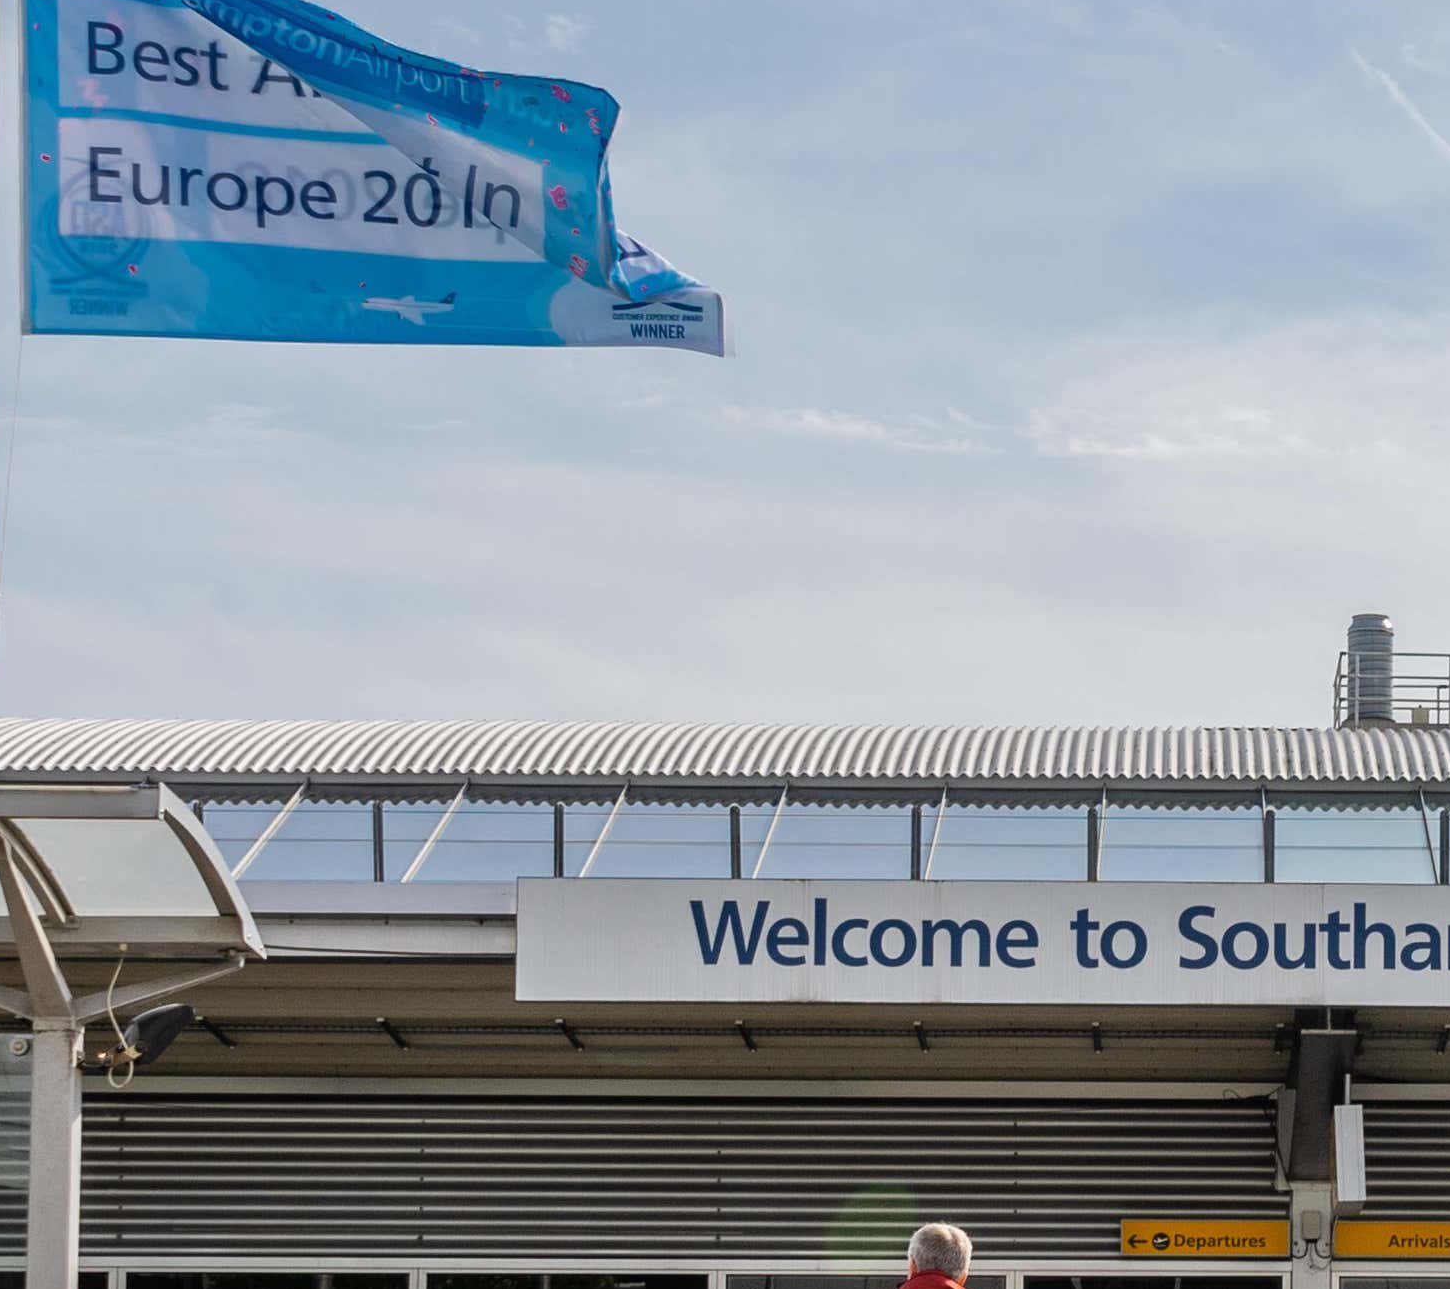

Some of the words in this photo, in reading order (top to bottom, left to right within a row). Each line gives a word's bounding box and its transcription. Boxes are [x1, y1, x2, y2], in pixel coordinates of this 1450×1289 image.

[87, 21, 228, 91] Best
[251, 58, 322, 98] A
[89, 146, 337, 228] Europe
[630, 323, 685, 339] WINNER
[689, 898, 1039, 967] Welcome
[1070, 908, 1148, 969] to
[1174, 1234, 1266, 1252] Departures
[1388, 1234, 1450, 1249] Arrivals
